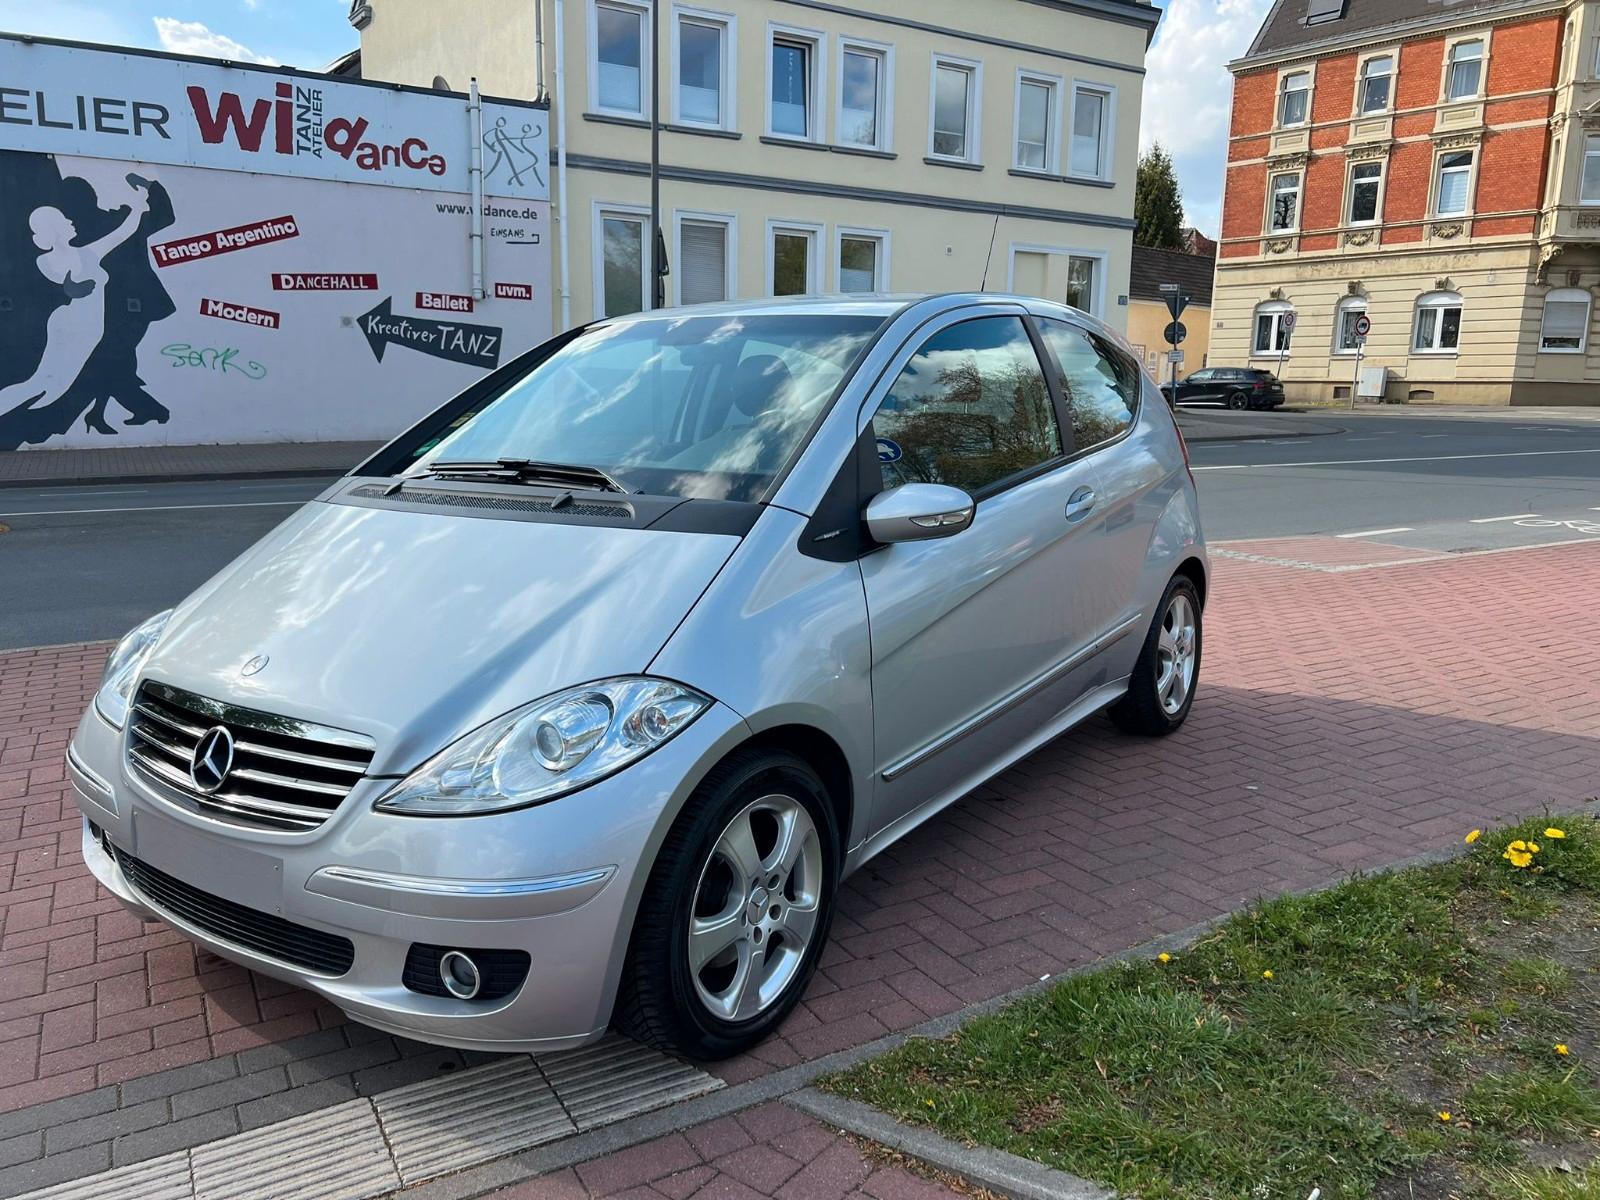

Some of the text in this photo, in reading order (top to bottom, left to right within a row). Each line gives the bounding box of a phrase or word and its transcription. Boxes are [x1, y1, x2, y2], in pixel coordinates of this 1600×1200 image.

[0, 87, 172, 139] ELIER
[296, 86, 312, 155] TANZ
[312, 89, 323, 159] ATELIER
[155, 222, 296, 261] Tango Argentino
[280, 274, 369, 290] DANCEHALL
[497, 285, 530, 298] uvm.
[207, 300, 275, 327] Modern
[422, 294, 469, 311] Ballett
[367, 315, 498, 357] Kreativer TANZ
